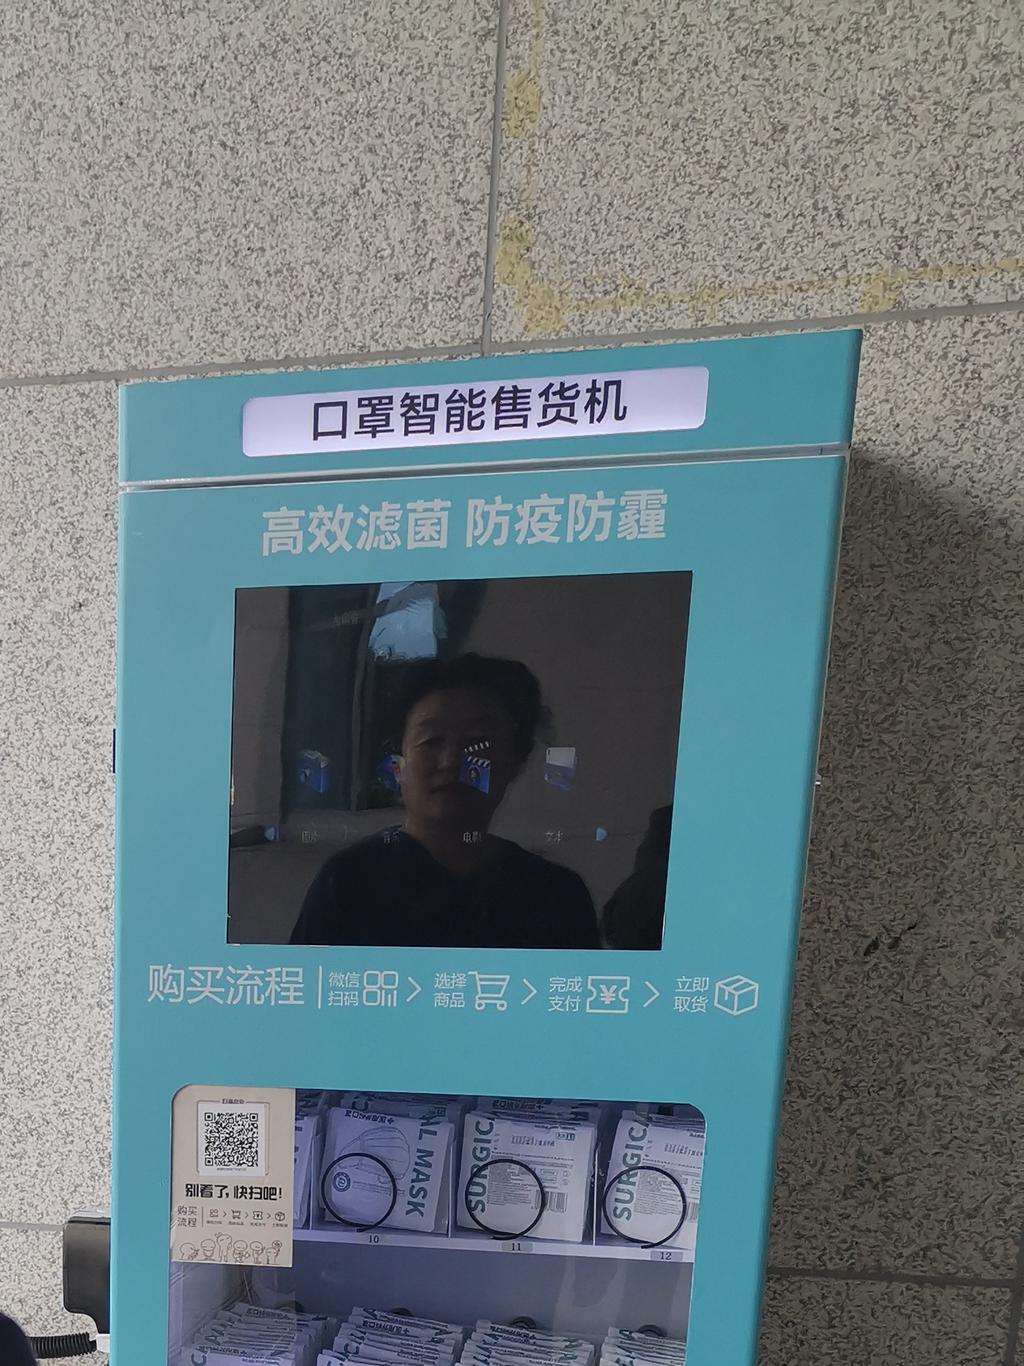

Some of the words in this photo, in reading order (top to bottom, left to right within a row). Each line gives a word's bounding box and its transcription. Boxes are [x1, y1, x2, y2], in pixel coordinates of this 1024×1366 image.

[312, 378, 628, 441] 口罩智能售货机
[261, 499, 452, 557] 高效滤菌
[466, 488, 667, 548] 防疫防霾
[147, 963, 305, 1006] 购买流程
[328, 971, 360, 988] 微信
[434, 972, 467, 989] 选择
[549, 976, 583, 993] 完成
[677, 976, 709, 993] 立即
[328, 990, 359, 1007] 扫码
[433, 992, 465, 1008] 商品
[548, 995, 581, 1012] 支付
[673, 996, 709, 1013] 取货
[467, 1117, 496, 1214] SURGIC
[405, 1148, 435, 1218] MASK
[177, 1205, 198, 1216] 购买
[177, 1217, 198, 1228] 流程
[368, 1235, 380, 1244] 10
[510, 1242, 522, 1251] 11
[660, 1251, 672, 1261] 12
